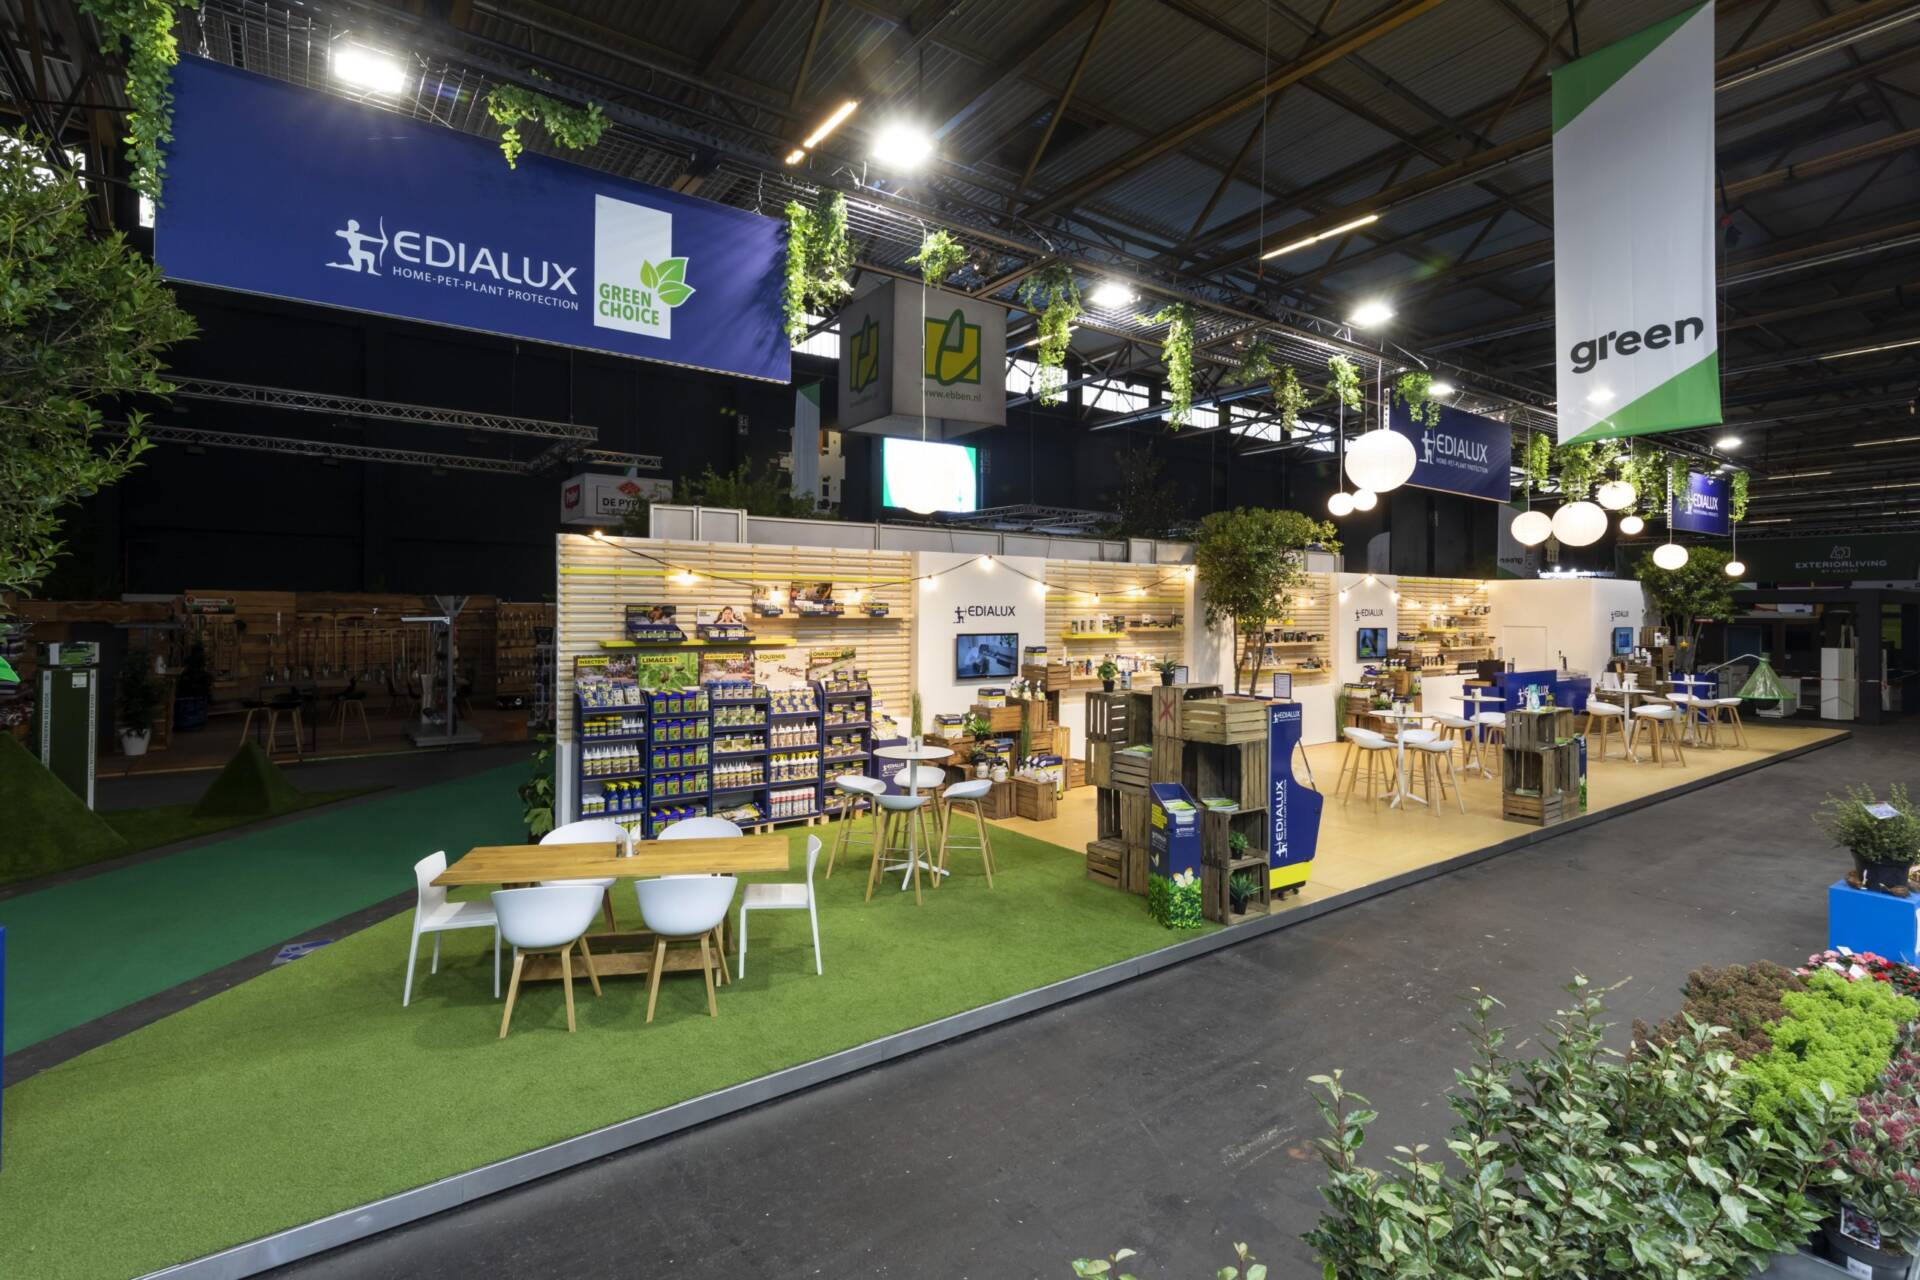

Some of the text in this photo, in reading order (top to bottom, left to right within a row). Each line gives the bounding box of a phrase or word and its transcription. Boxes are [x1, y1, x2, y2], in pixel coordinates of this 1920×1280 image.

[393, 230, 578, 295] EDIALUX
[392, 266, 579, 311] HOME-PET-PLANT PROTECTION
[599, 283, 651, 308] GREEN
[599, 300, 660, 326] CHOICE
[1570, 316, 1704, 374] green
[1436, 433, 1489, 464] EDIALUX
[602, 498, 617, 507] DE
[1693, 492, 1719, 511] EDIALUX
[1795, 560, 1888, 569] EXTERIORLIVING
[967, 605, 1016, 617] EDIALUX
[1360, 608, 1384, 617] EDIALUX
[1275, 780, 1284, 841] EDIALUX
